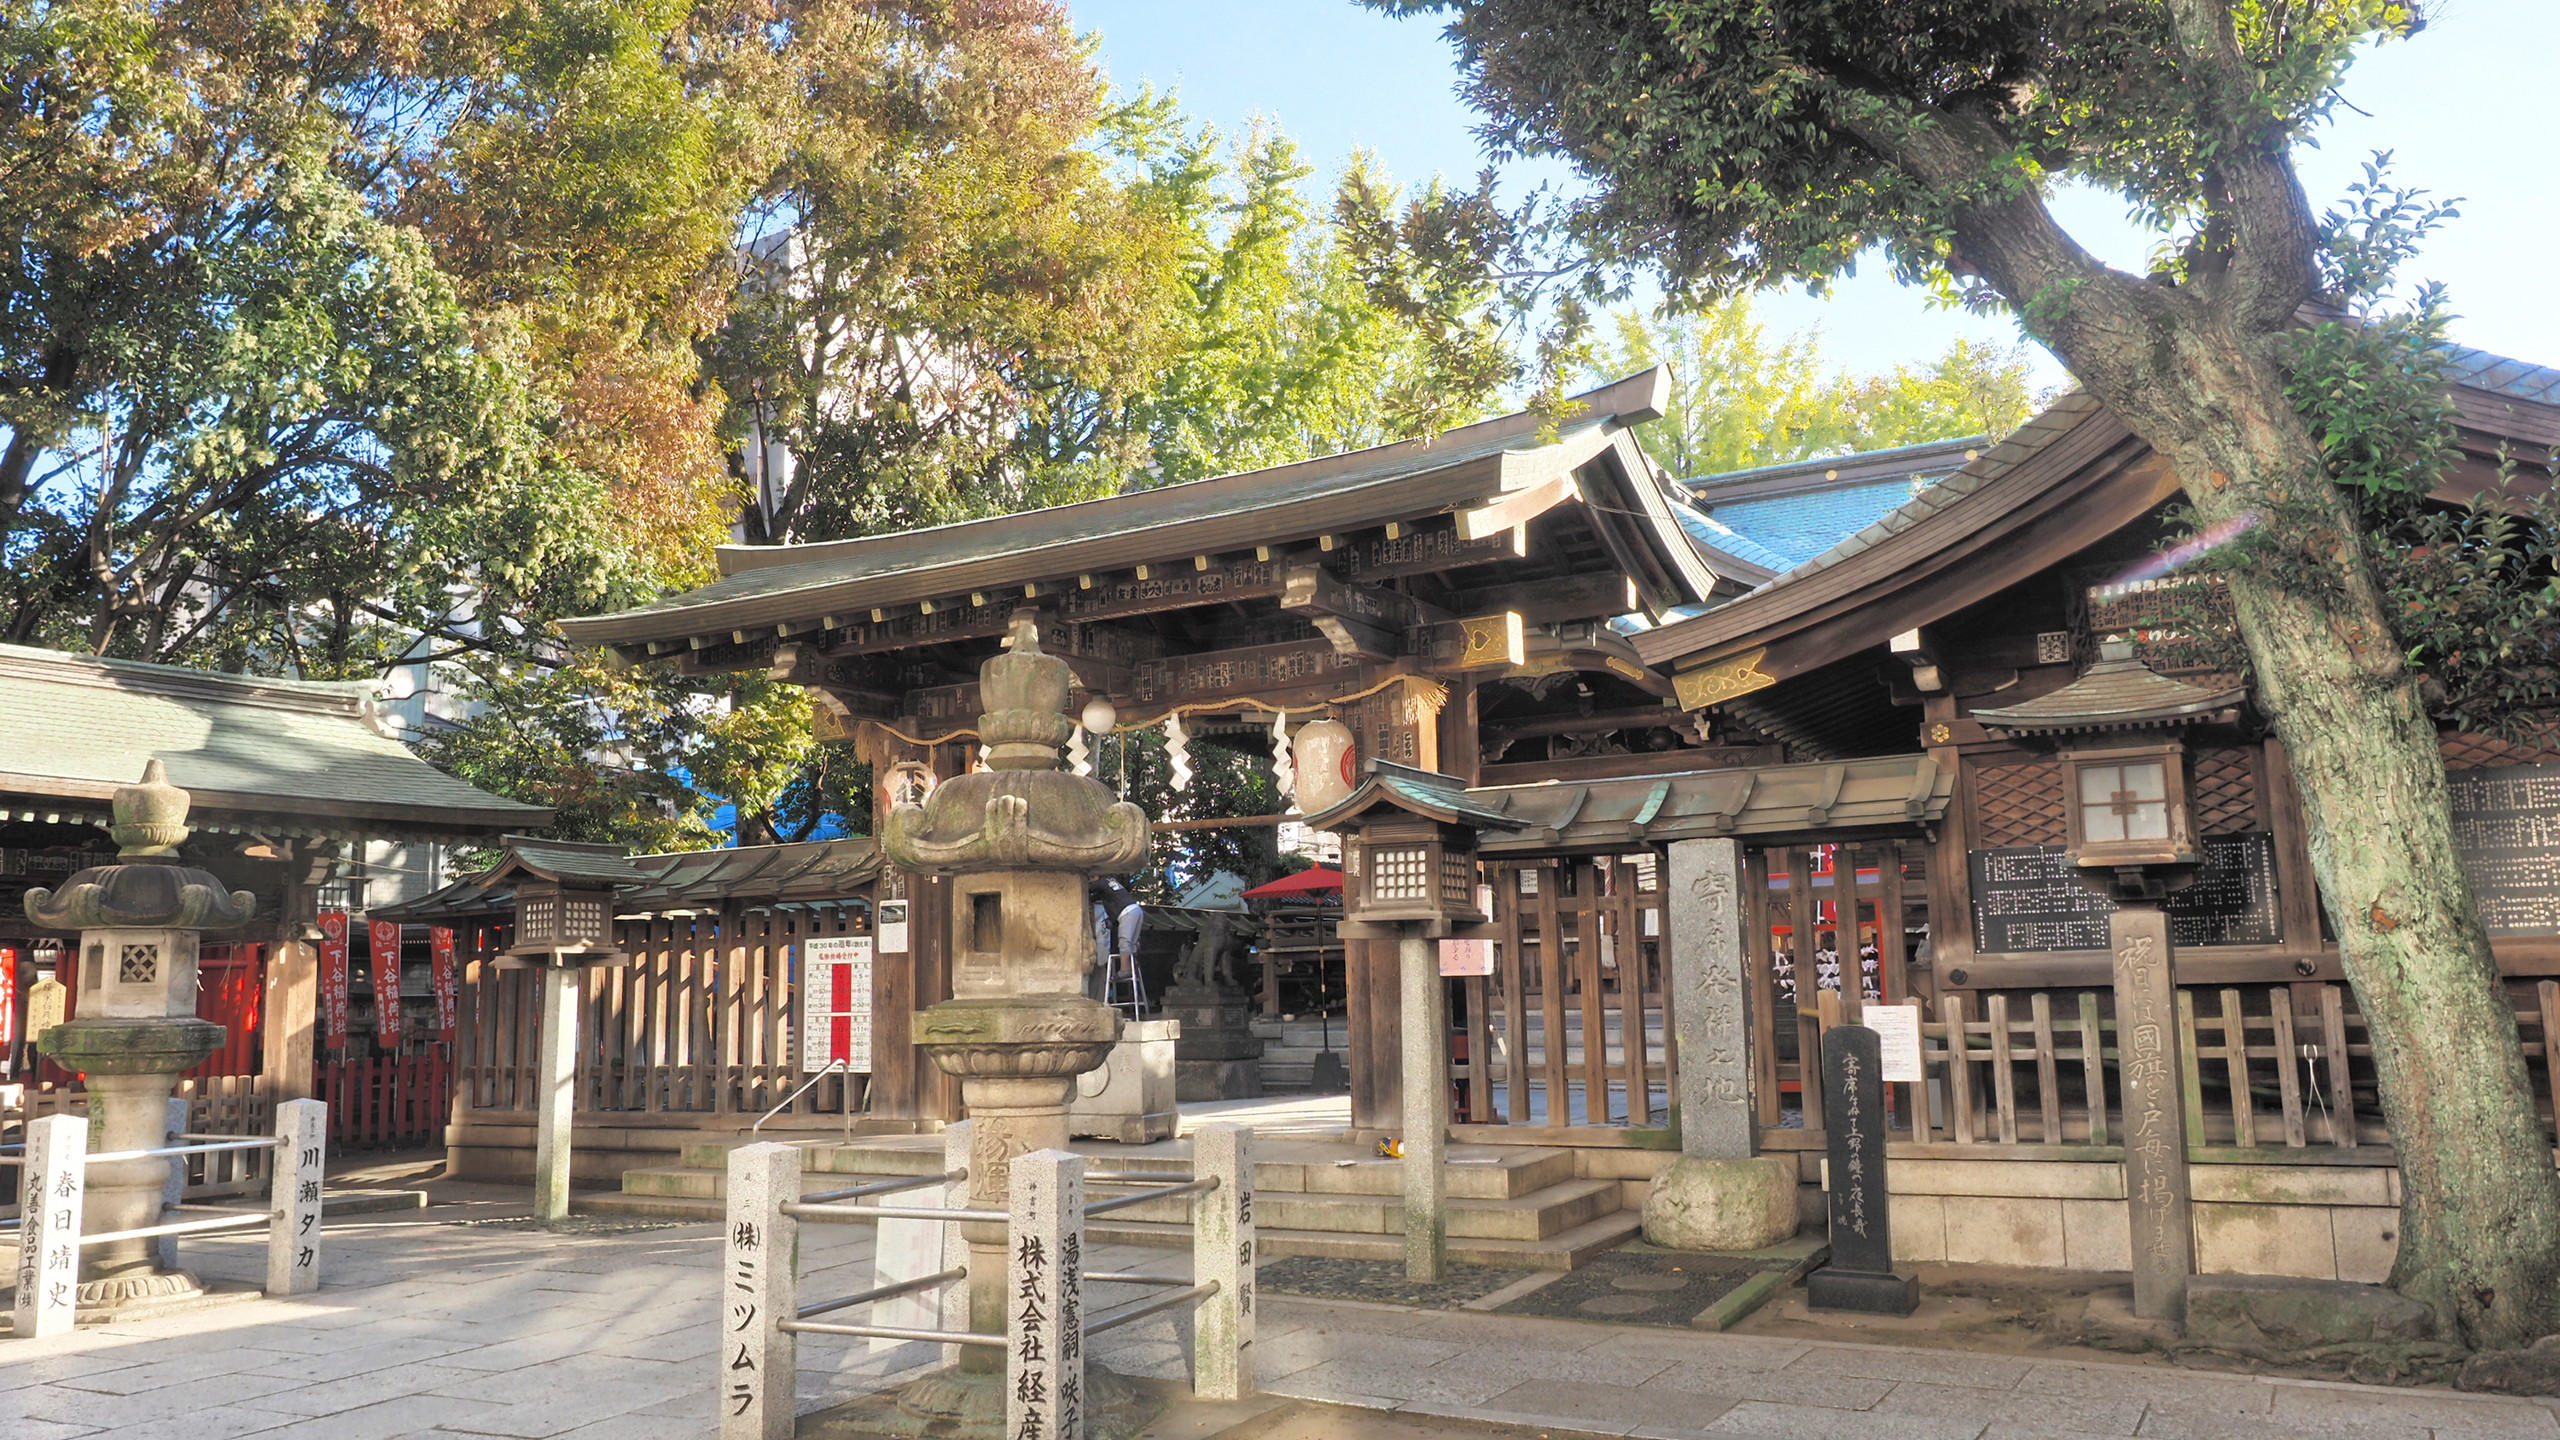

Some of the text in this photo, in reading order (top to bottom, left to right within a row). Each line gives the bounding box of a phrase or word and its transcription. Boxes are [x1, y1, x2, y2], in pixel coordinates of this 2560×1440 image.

[330, 949, 346, 1034] 下谷稲荷社
[381, 950, 401, 1033] 下谷稲荷社
[440, 948, 455, 1029] 下谷稲荷社
[48, 1170, 78, 1310] 春日靖史
[1237, 1190, 1253, 1351] 岩田賢一
[731, 1220, 761, 1416] (株)ミツムラ
